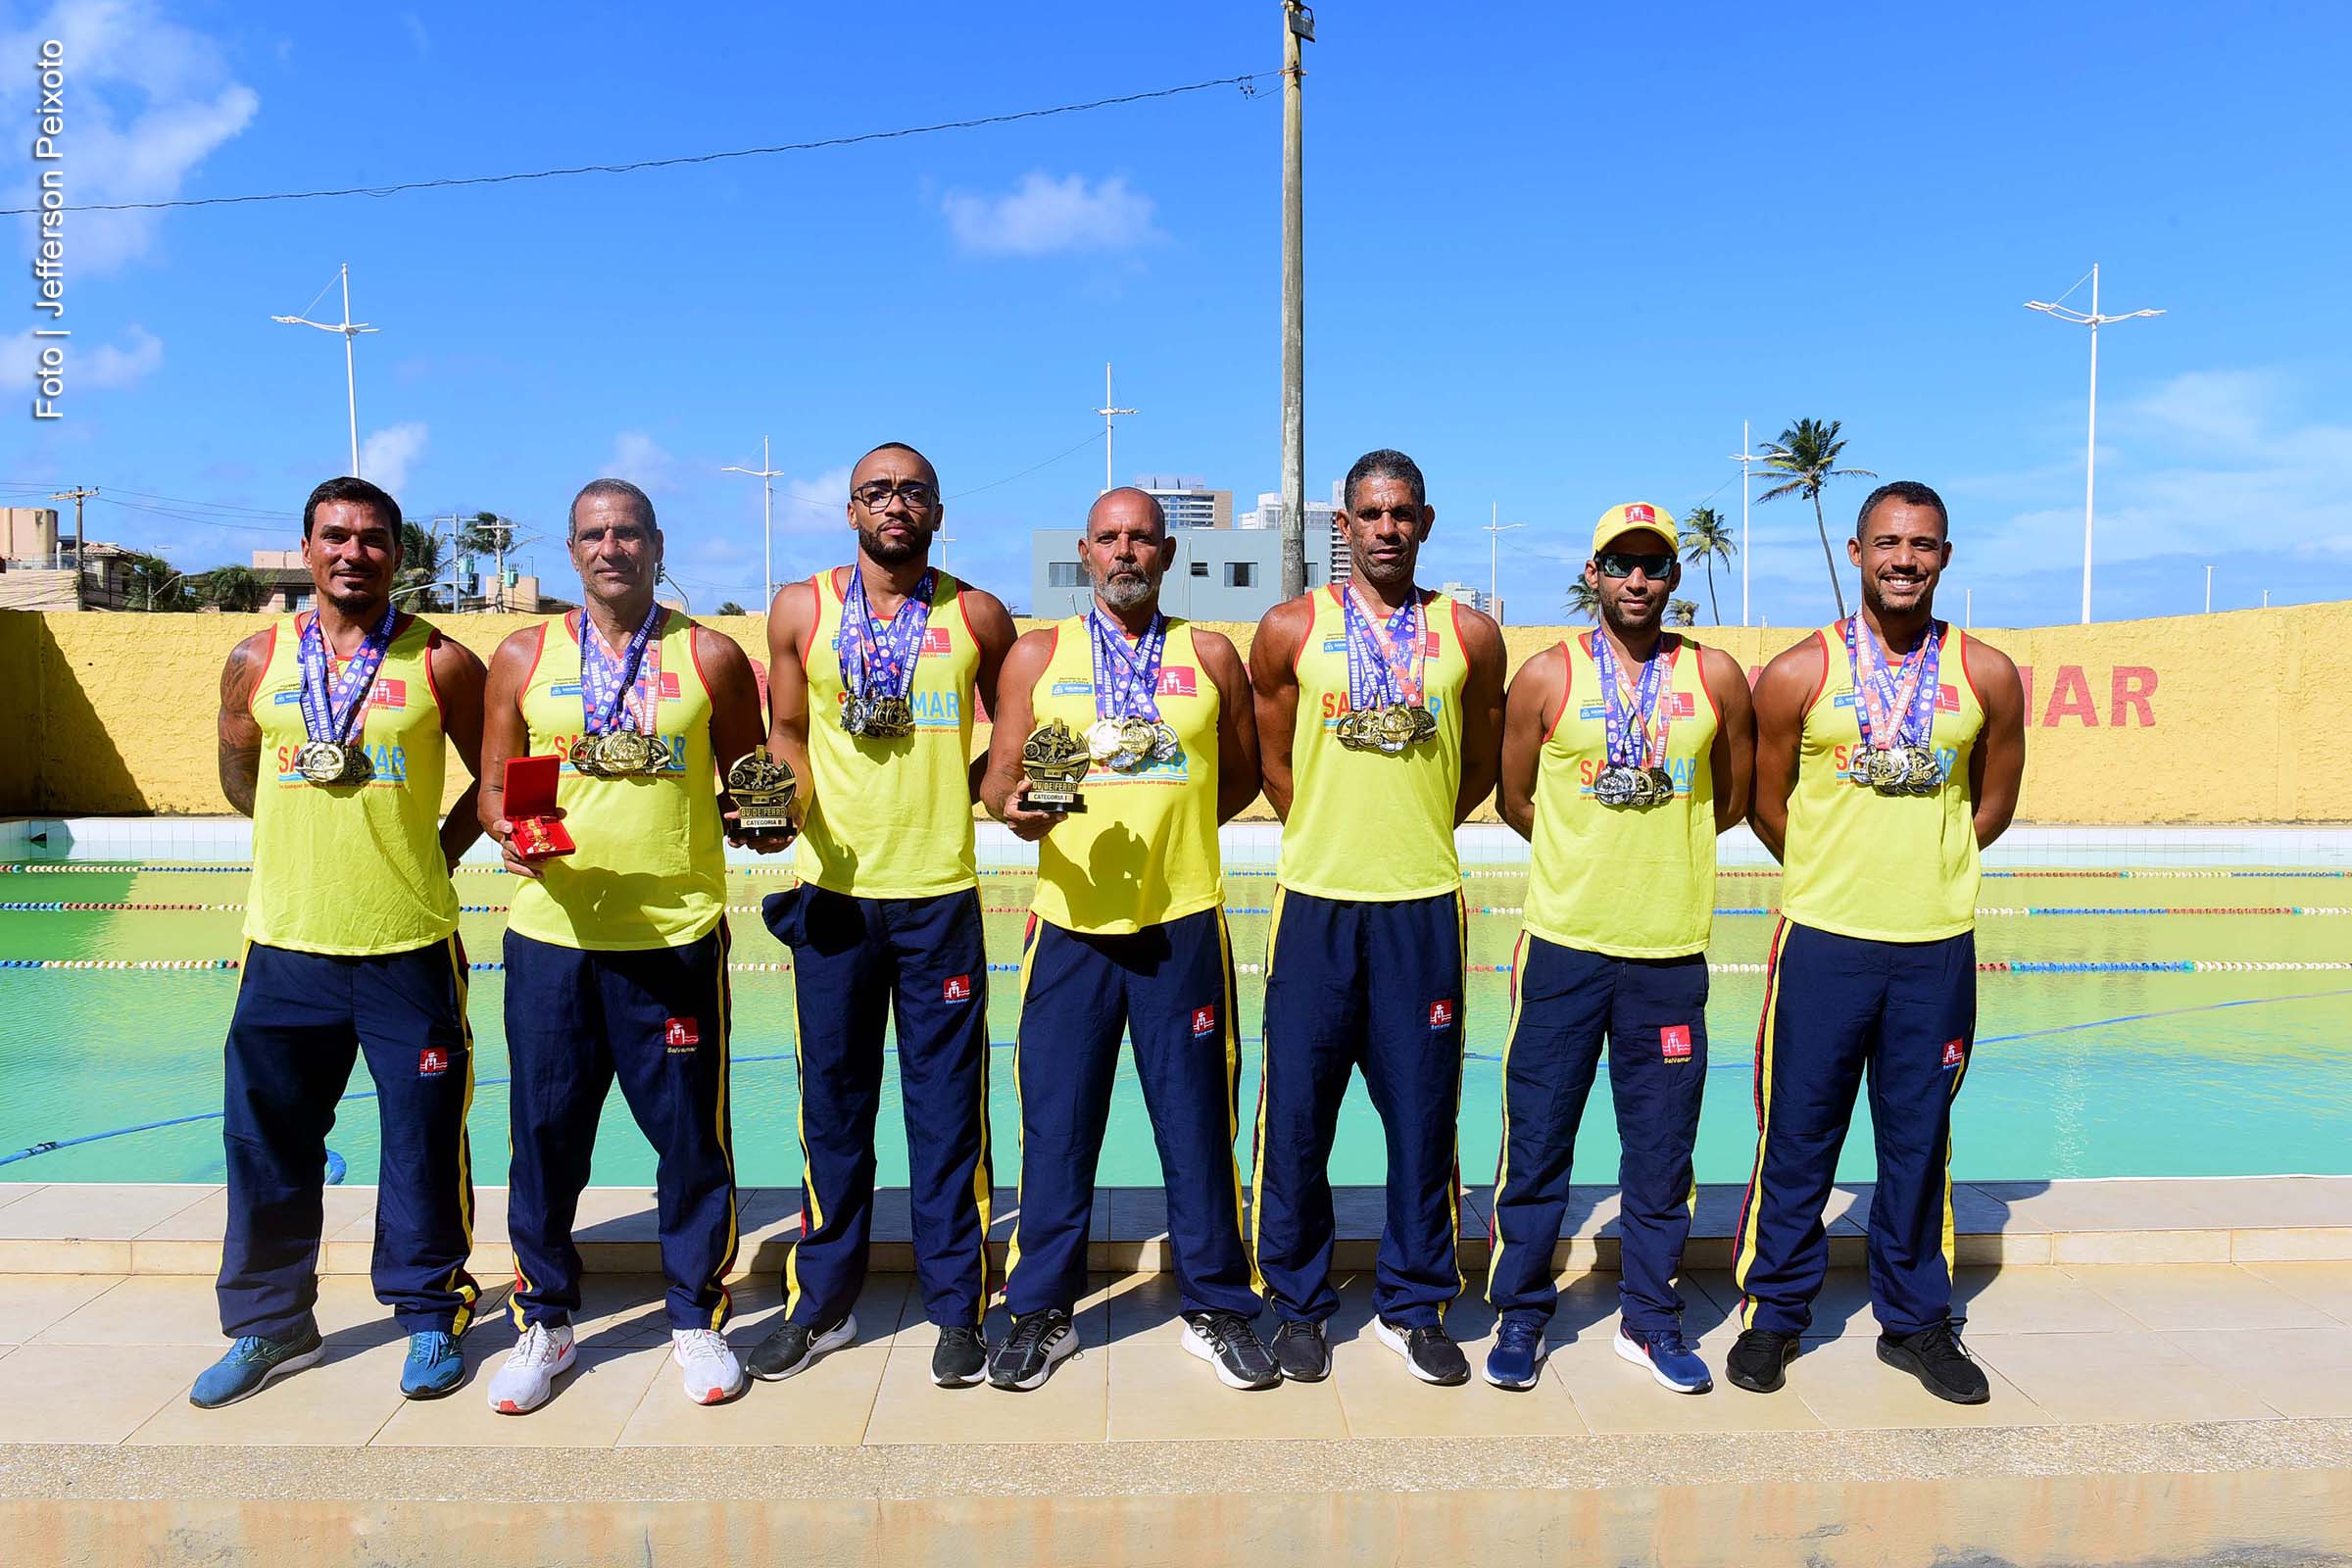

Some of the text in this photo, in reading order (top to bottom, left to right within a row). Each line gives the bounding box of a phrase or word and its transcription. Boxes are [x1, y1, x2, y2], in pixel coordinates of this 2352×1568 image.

[631, 626, 648, 650] RESCUE
[1356, 642, 1373, 673] SOBRASA
[1349, 661, 1360, 691] SOBRASA
[1104, 694, 1113, 717] OBRASA
[1054, 783, 1077, 792] FERRO
[753, 808, 761, 816] DE
[763, 808, 786, 816] FERRO
